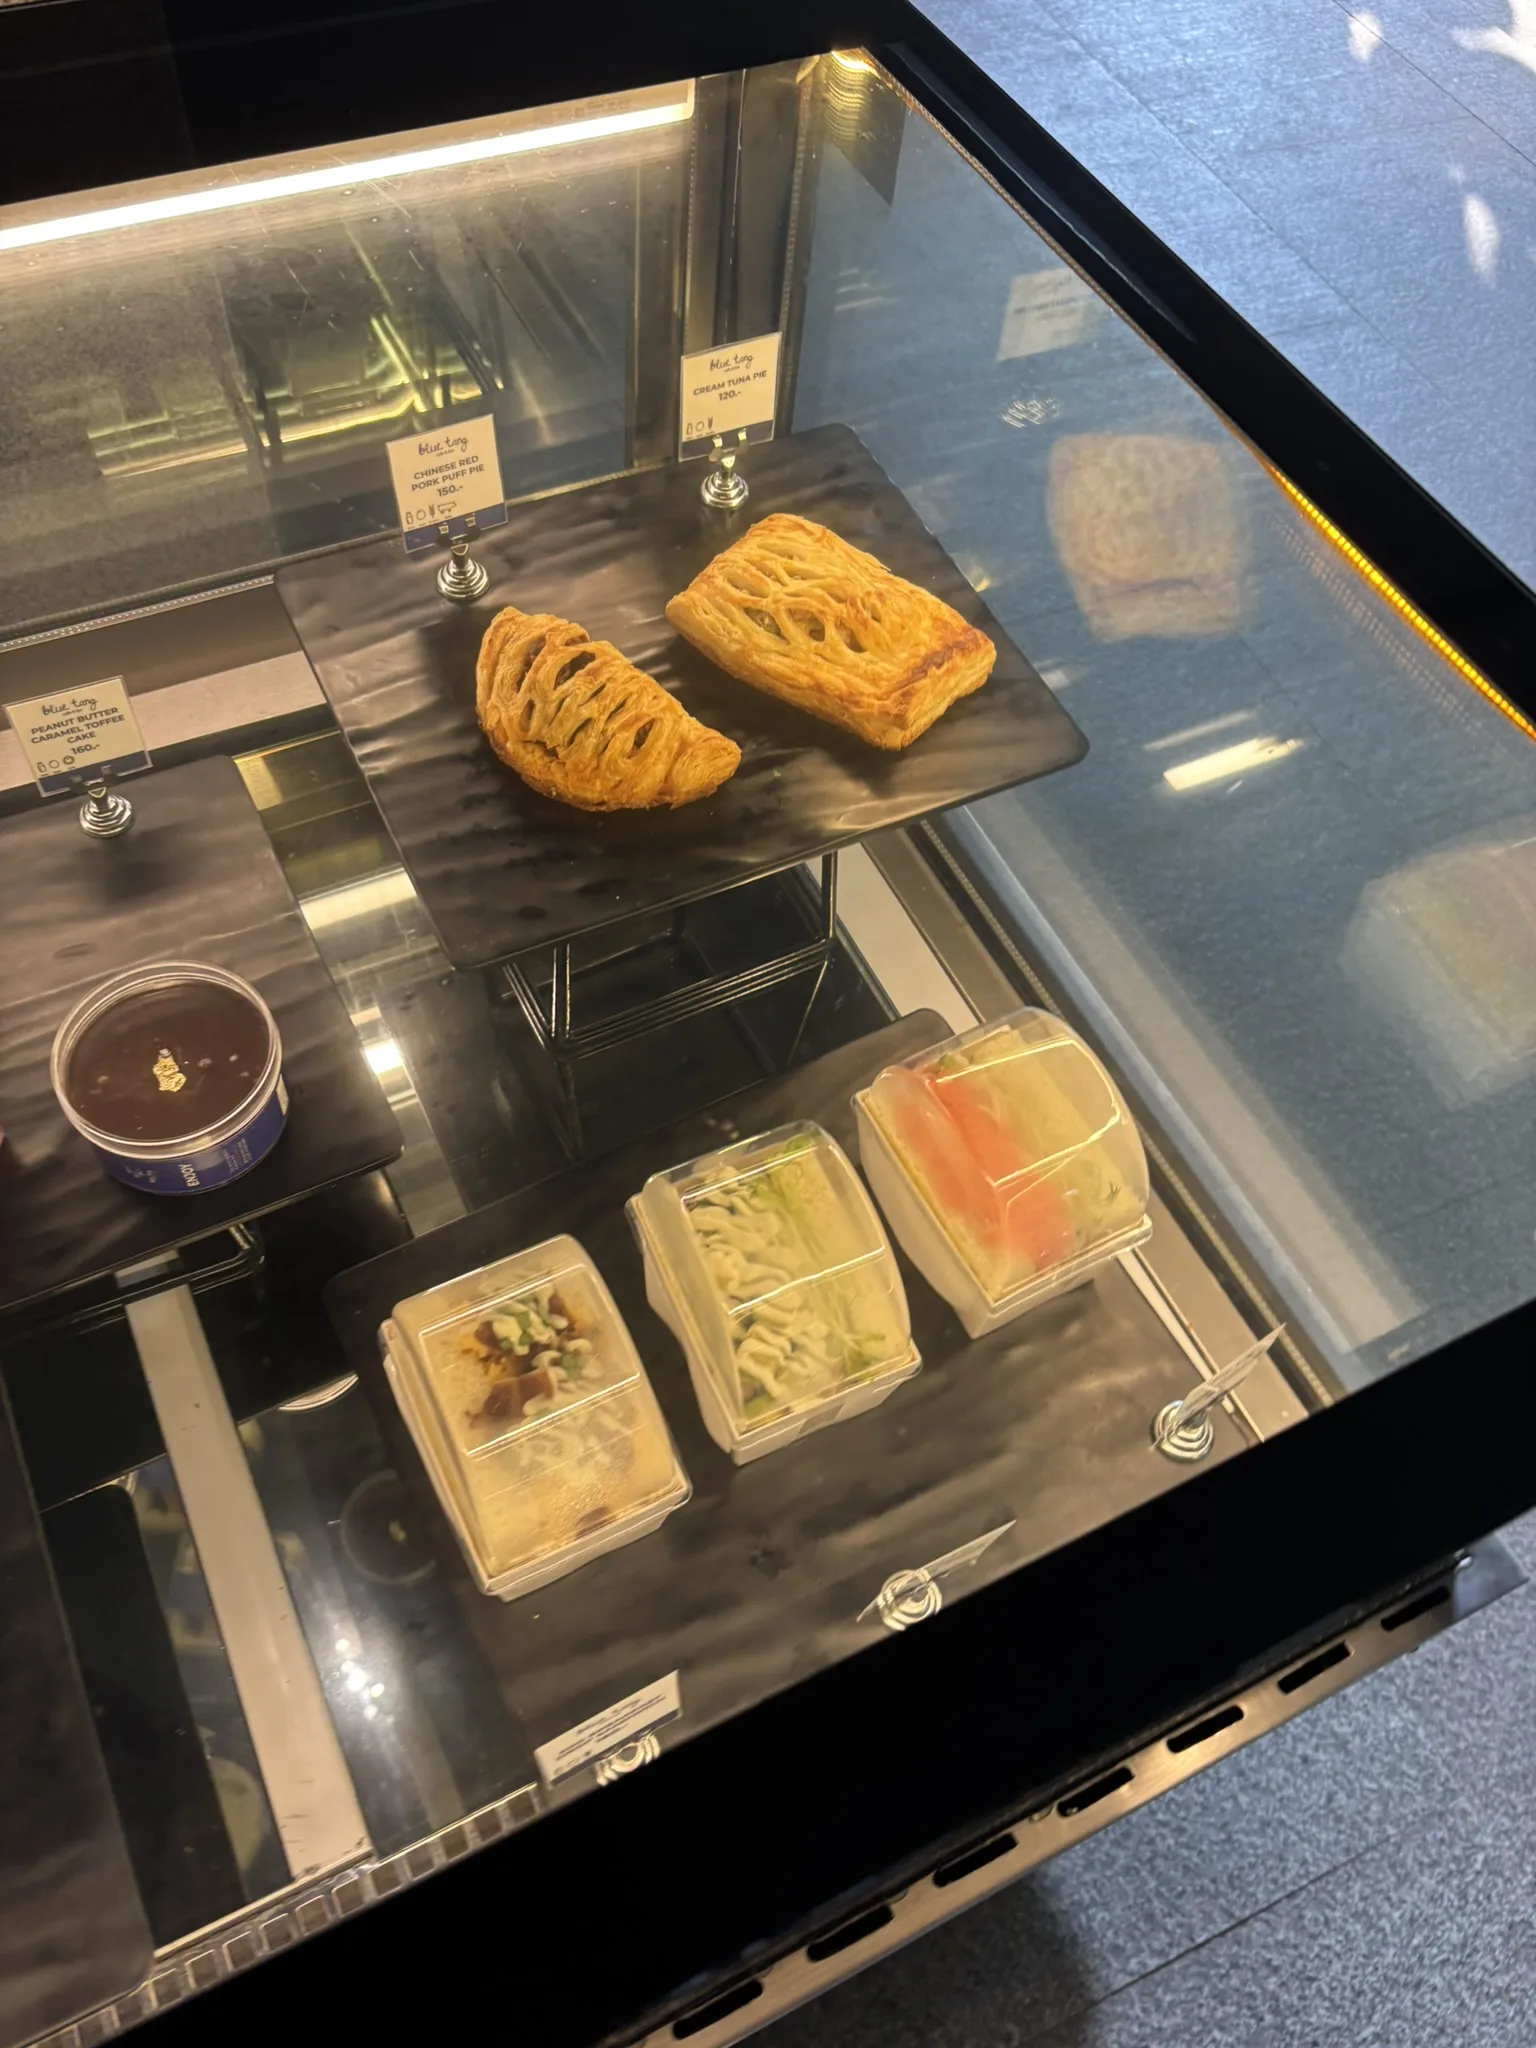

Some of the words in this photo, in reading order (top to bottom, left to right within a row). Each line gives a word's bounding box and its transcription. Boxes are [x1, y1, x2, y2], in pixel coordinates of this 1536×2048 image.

[709, 358, 731, 371] blue
[732, 353, 754, 370] tang
[693, 381, 725, 396] CREAM
[727, 376, 751, 387] TUNA
[753, 370, 767, 380] PIE
[719, 390, 742, 401] 120.-
[418, 442, 443, 455] blue
[444, 436, 469, 452] tang
[414, 462, 457, 480] CHINESE
[459, 455, 479, 467] RED
[411, 477, 440, 491] PORK
[442, 469, 468, 483] PUFF
[469, 464, 485, 476] PIE
[437, 485, 463, 497] 150.-
[42, 703, 69, 716] blue
[71, 698, 99, 711] tang
[31, 718, 75, 734] PEANUT
[78, 707, 119, 722] BUTTER
[31, 727, 84, 744] CARAMEL
[86, 715, 125, 729] TOFFEE
[67, 732, 96, 744] CAKE
[71, 744, 100, 755] 160.-
[178, 1163, 200, 1187] ENJOY
